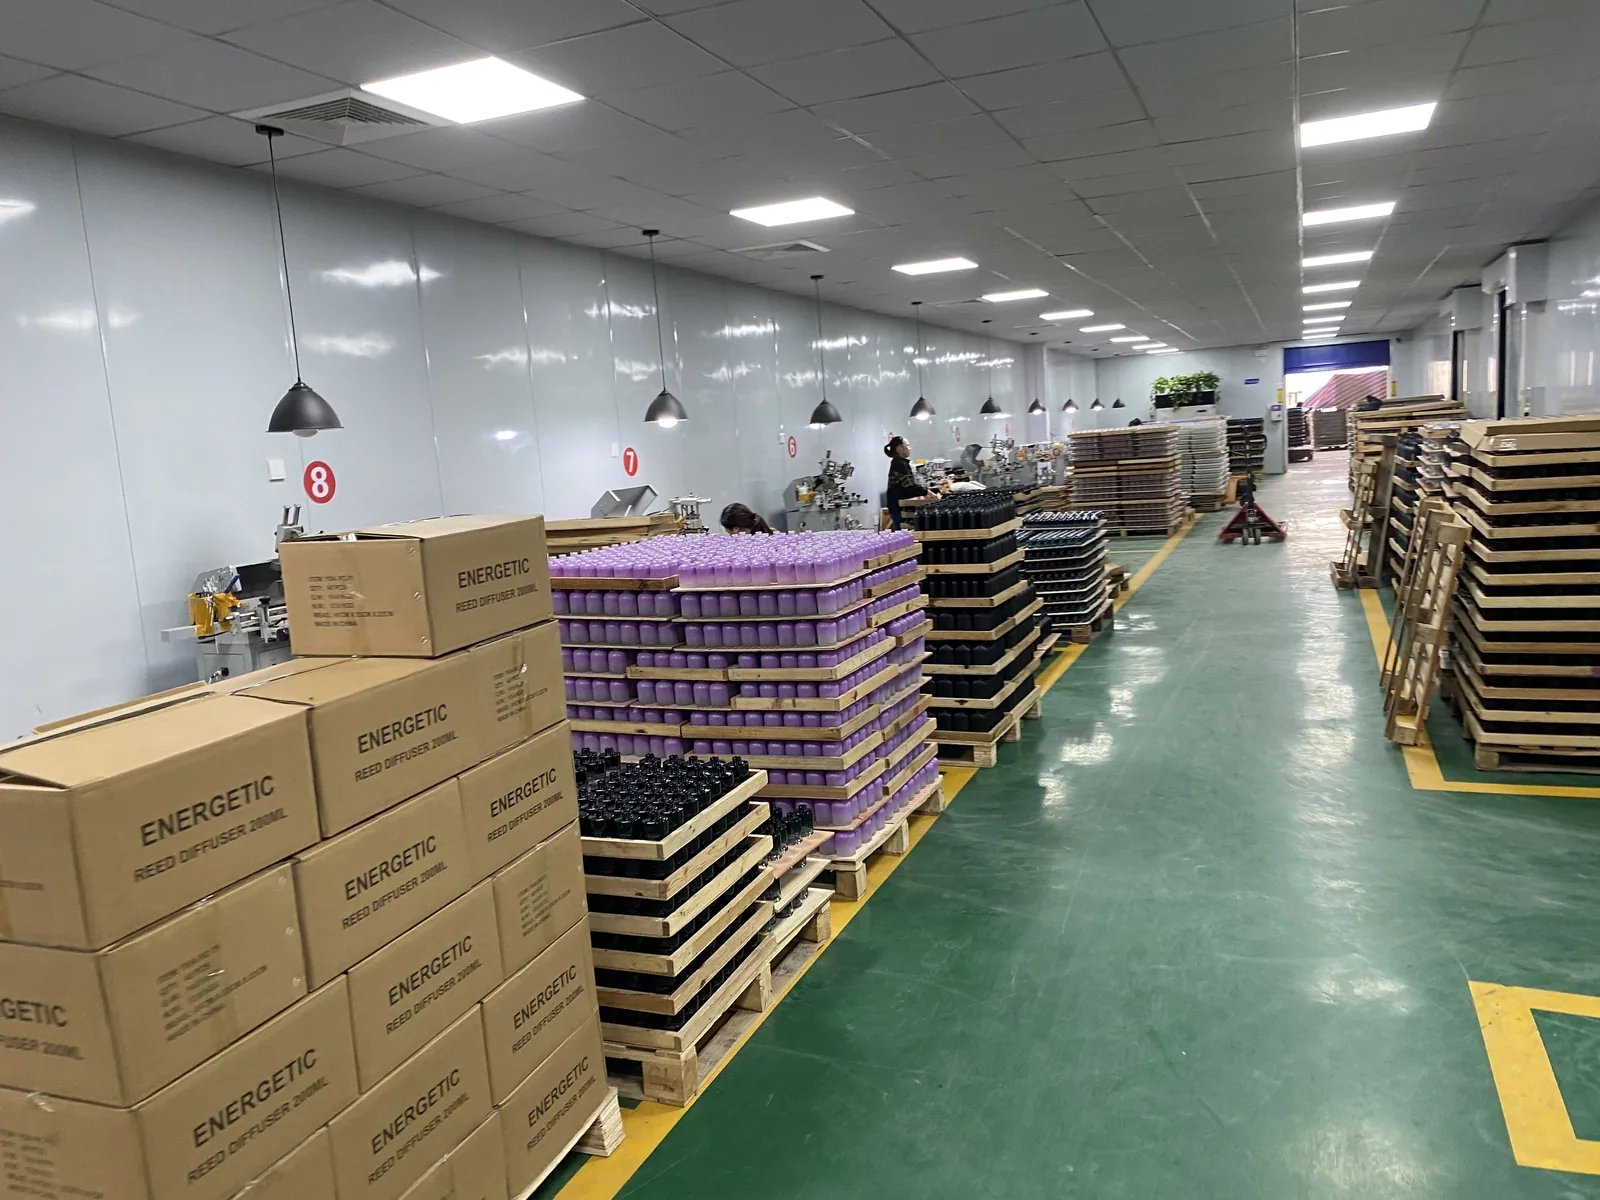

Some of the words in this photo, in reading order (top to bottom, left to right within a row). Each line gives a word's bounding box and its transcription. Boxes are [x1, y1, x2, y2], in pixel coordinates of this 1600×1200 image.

[310, 466, 329, 498] 8
[626, 451, 634, 473] 7
[458, 558, 530, 588] ENERGETIC
[456, 599, 478, 613] REED
[480, 588, 516, 607] DIFFUSER
[357, 704, 447, 754] ENERGETIC
[355, 762, 382, 782] REED
[384, 742, 430, 770] DIFFUSER
[140, 775, 274, 847] ENERGETIC
[490, 768, 557, 818] ENERGETIC
[487, 824, 508, 843] REED
[509, 802, 542, 831] DIFFUSER
[134, 855, 176, 883] REED
[179, 824, 247, 864] DIFFUSER
[344, 835, 437, 901] ENERGETIC
[342, 905, 370, 930] REED
[372, 876, 419, 912] DIFFUSER
[388, 935, 472, 1007] ENERGETIC
[513, 965, 577, 1030] ENERGETIC
[386, 1009, 412, 1035] REED
[414, 976, 456, 1015] DIFFUSER
[533, 1001, 564, 1036] DIFFUSER
[193, 1048, 317, 1148] ENERGETIC
[372, 1069, 460, 1155] ENERGETIC
[528, 1056, 589, 1128] ENERGETIC
[188, 1150, 225, 1184] REED
[228, 1102, 290, 1156] DIFFUSER
[396, 1115, 442, 1160] DIFFUSER
